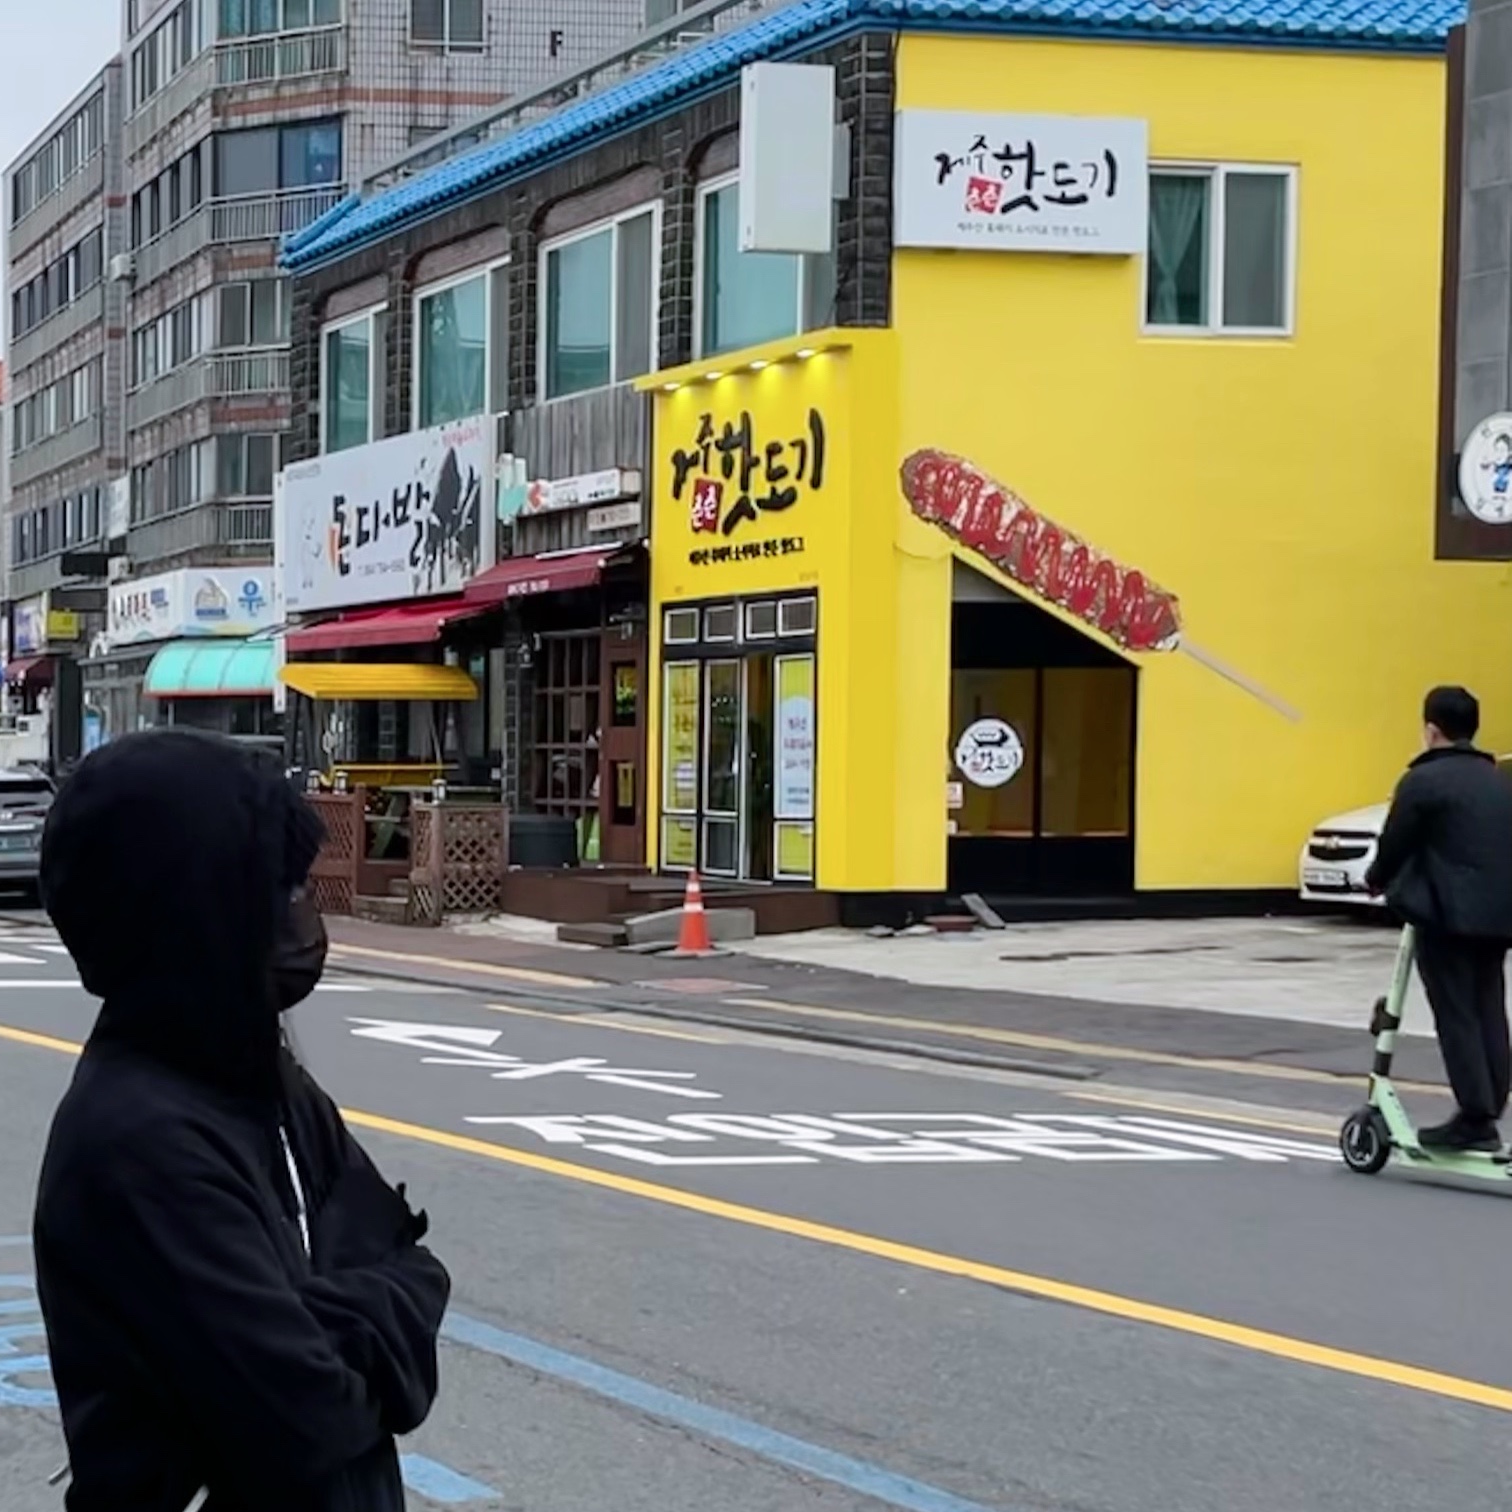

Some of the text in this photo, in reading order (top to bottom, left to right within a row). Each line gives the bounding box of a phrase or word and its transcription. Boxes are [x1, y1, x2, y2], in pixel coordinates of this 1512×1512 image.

[550, 30, 563, 57] F
[992, 140, 1117, 214] 핫도기
[714, 408, 825, 537] 핫도기
[463, 1112, 1345, 1163] 진입금지
